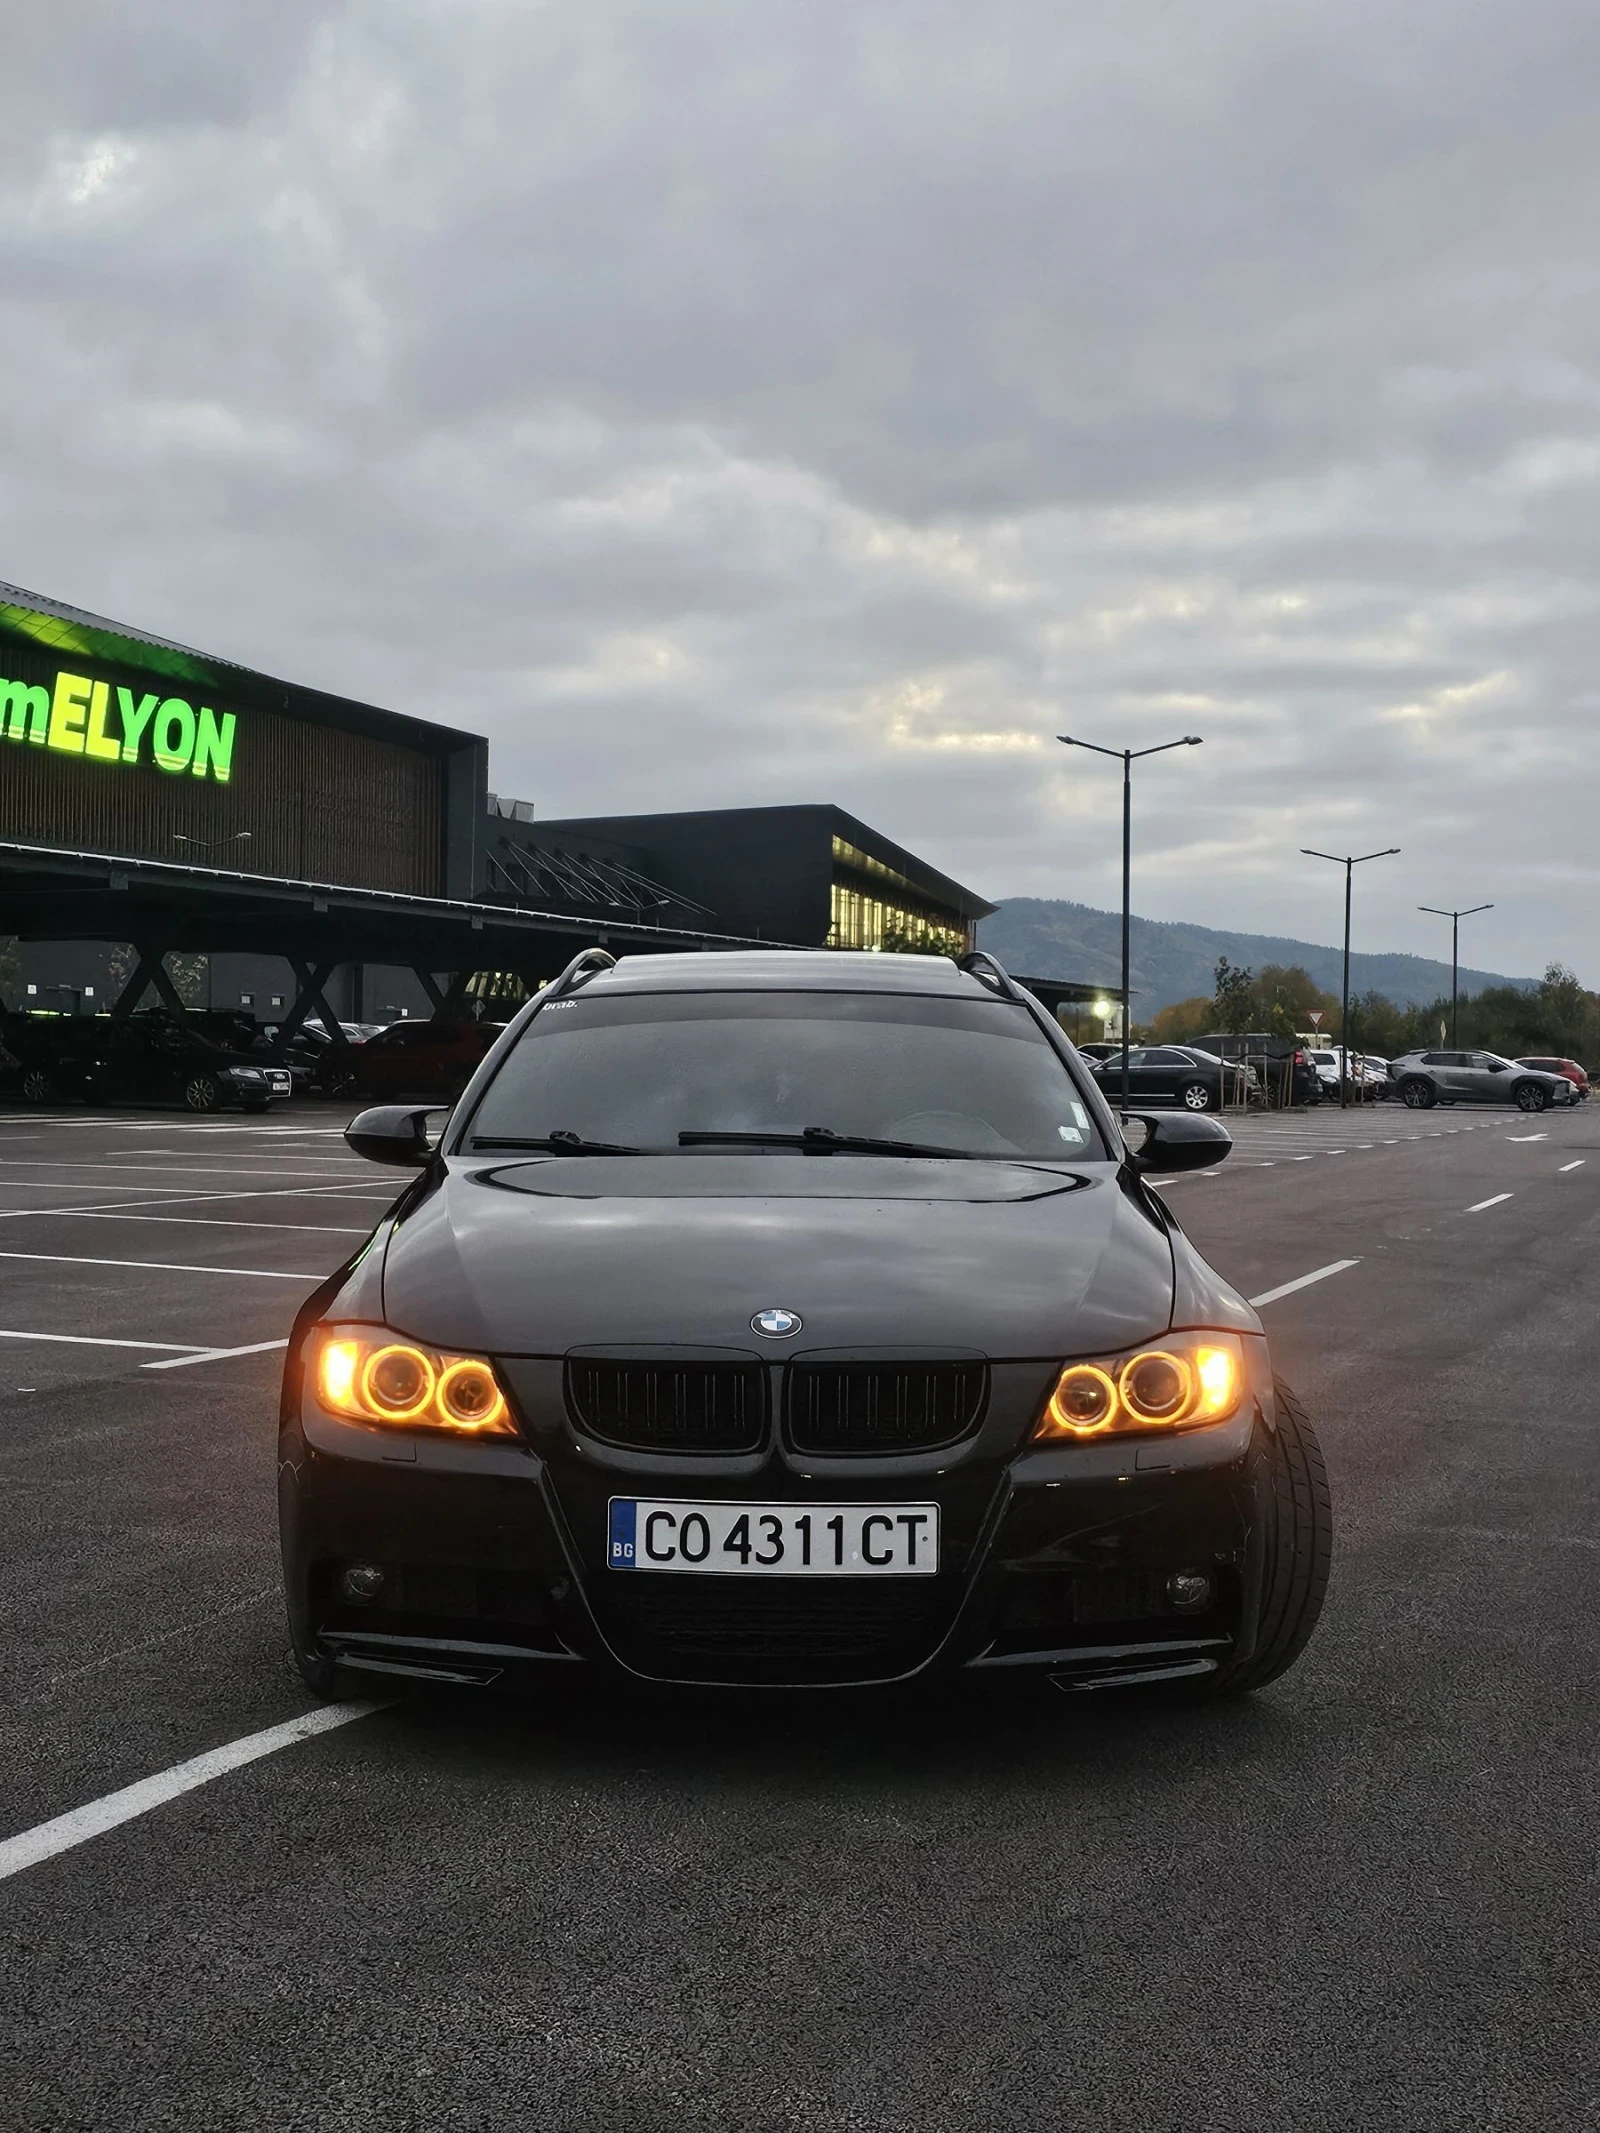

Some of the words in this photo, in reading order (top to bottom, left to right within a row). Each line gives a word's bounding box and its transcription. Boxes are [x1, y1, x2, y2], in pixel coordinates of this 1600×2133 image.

[612, 1542, 634, 1558] BG
[645, 1510, 711, 1562] CO
[723, 1514, 844, 1565] 4311
[861, 1514, 928, 1566] CT
